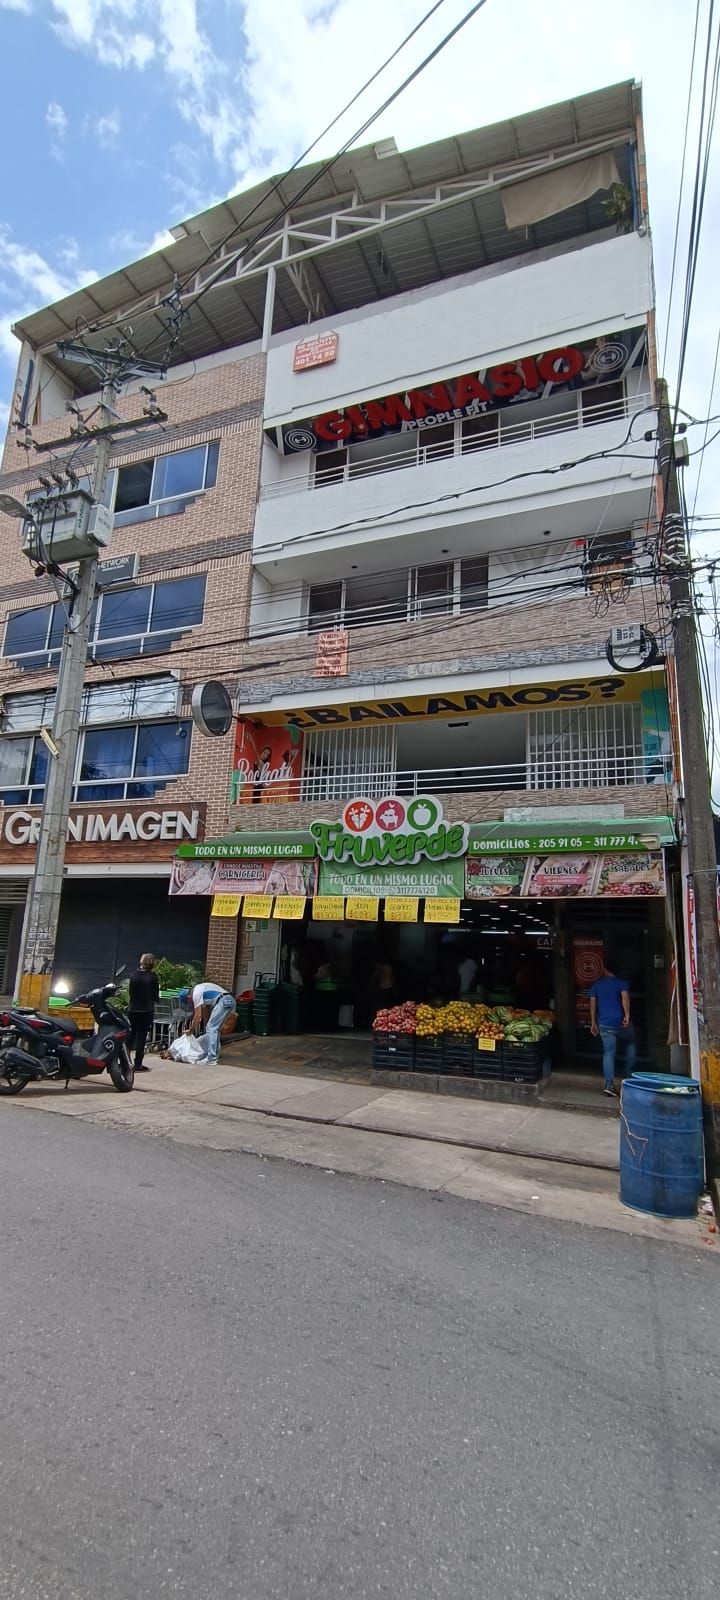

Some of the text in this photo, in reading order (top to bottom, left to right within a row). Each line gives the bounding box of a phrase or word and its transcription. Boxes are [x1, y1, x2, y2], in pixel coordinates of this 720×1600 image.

[314, 347, 584, 441] GIMNASIO
[407, 401, 489, 431] PEOPLE FIT
[284, 678, 625, 729] ¿BAILAMOS?
[5, 810, 200, 845] GRN IMAGEN
[194, 845, 303, 855] TODO EN UN MISMO LUGAR
[310, 822, 465, 863] Fruverde
[539, 838, 556, 848] 205
[557, 838, 568, 848] 91
[570, 838, 582, 847] 05
[594, 837, 607, 847] 311
[609, 836, 626, 846] 777
[329, 874, 454, 885] TODO EN UN MISMO LUGAR
[479, 867, 510, 876] JUEVES
[543, 866, 578, 875] VIERNES
